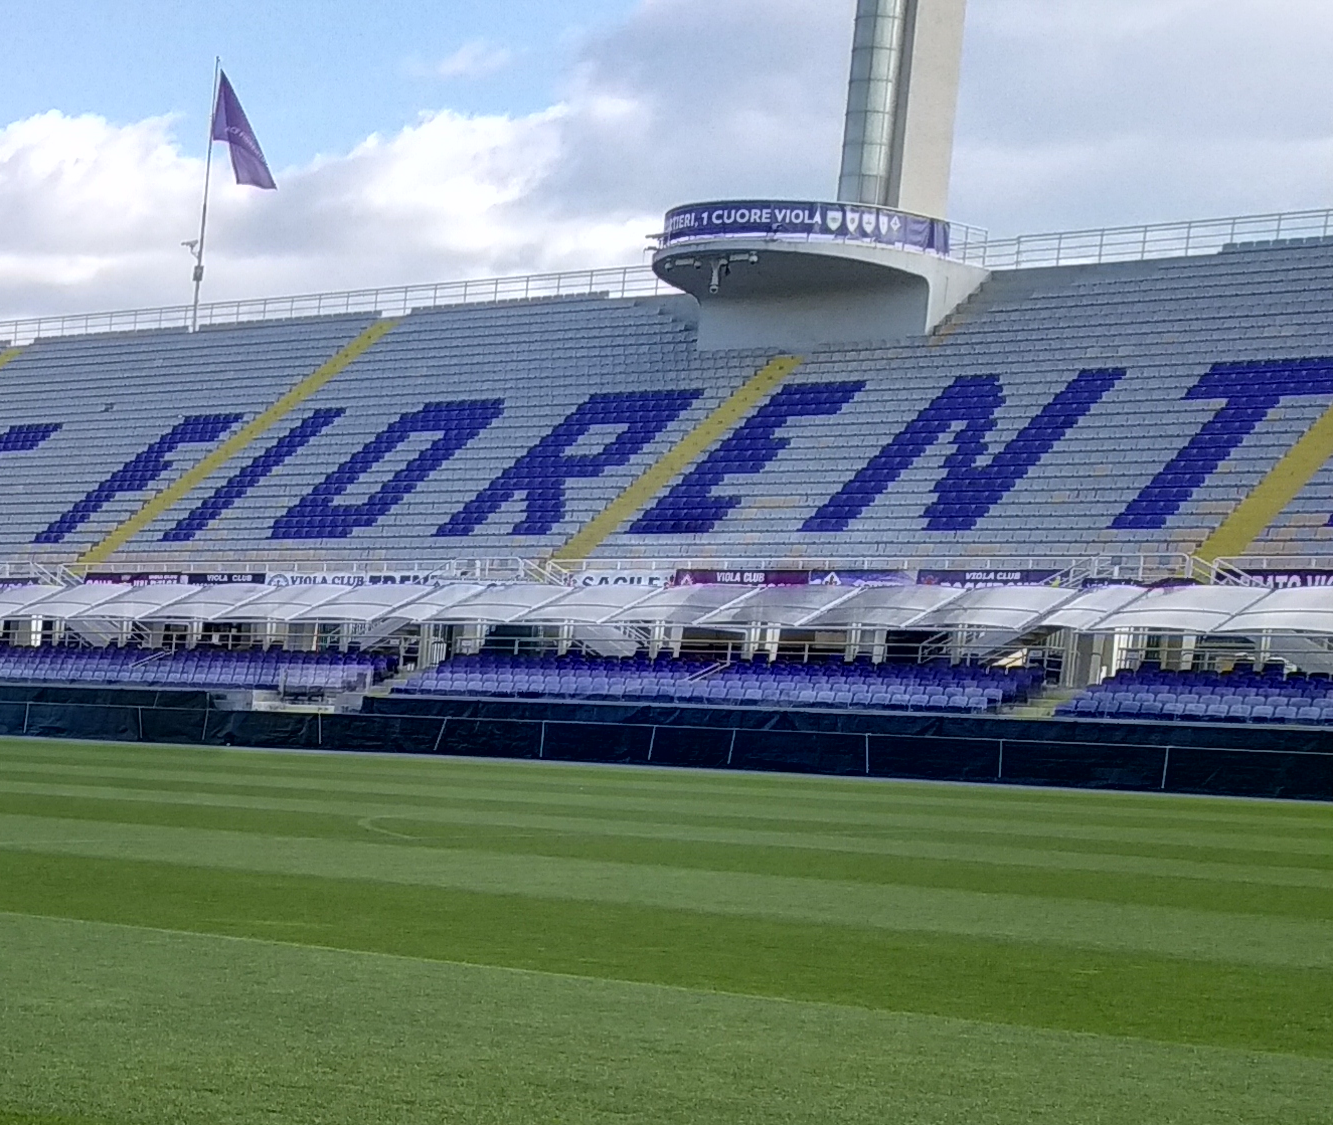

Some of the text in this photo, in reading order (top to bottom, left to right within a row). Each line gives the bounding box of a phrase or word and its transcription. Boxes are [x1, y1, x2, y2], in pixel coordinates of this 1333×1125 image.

[701, 211, 709, 226] 1
[712, 209, 771, 224] CUORE
[774, 209, 822, 225] VIOLA
[33, 356, 1333, 544] FIORENT
[207, 574, 252, 582] VIOLA CLUB
[290, 575, 328, 587] VIOLA
[332, 575, 364, 587] CLUB
[716, 572, 765, 582] VIOLA CLUB
[965, 572, 1021, 580] VIOLA CLUB
